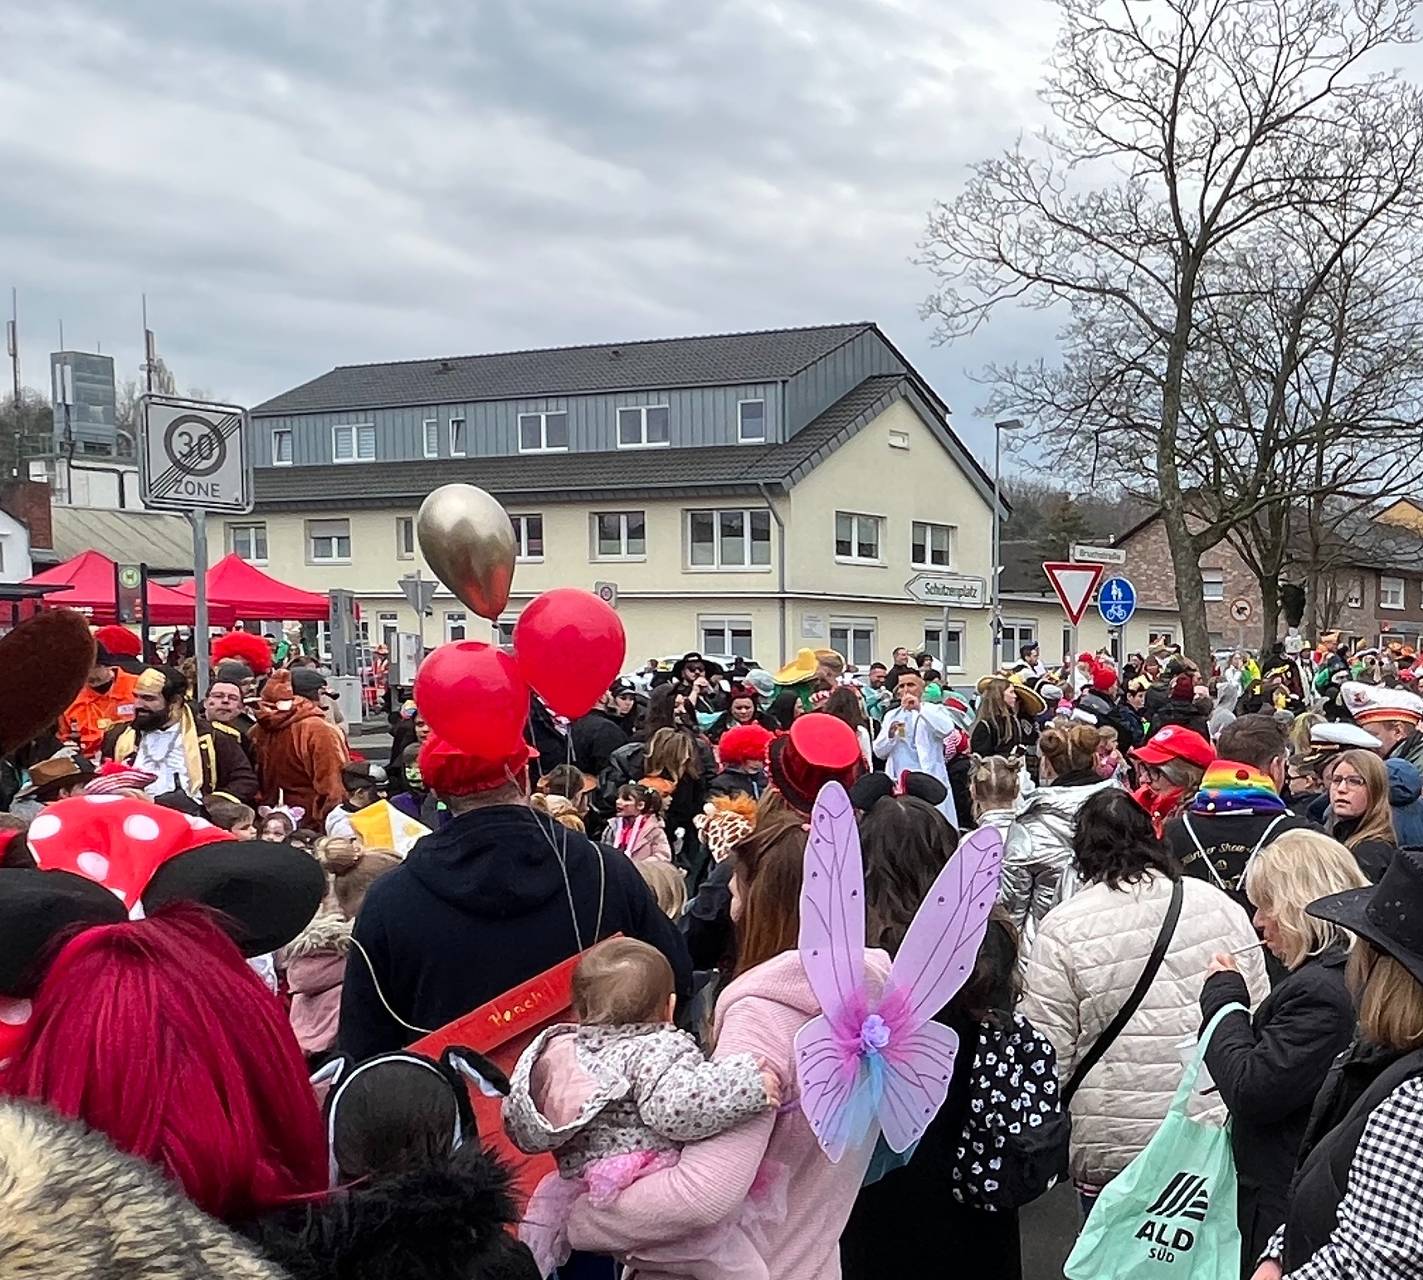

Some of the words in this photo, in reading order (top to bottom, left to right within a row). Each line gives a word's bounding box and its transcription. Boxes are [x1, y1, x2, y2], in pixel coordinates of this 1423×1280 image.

[178, 431, 214, 461] 30
[174, 479, 221, 498] ZONE
[924, 582, 978, 599] Schützenplatz
[1148, 1246, 1175, 1263] SÜD
